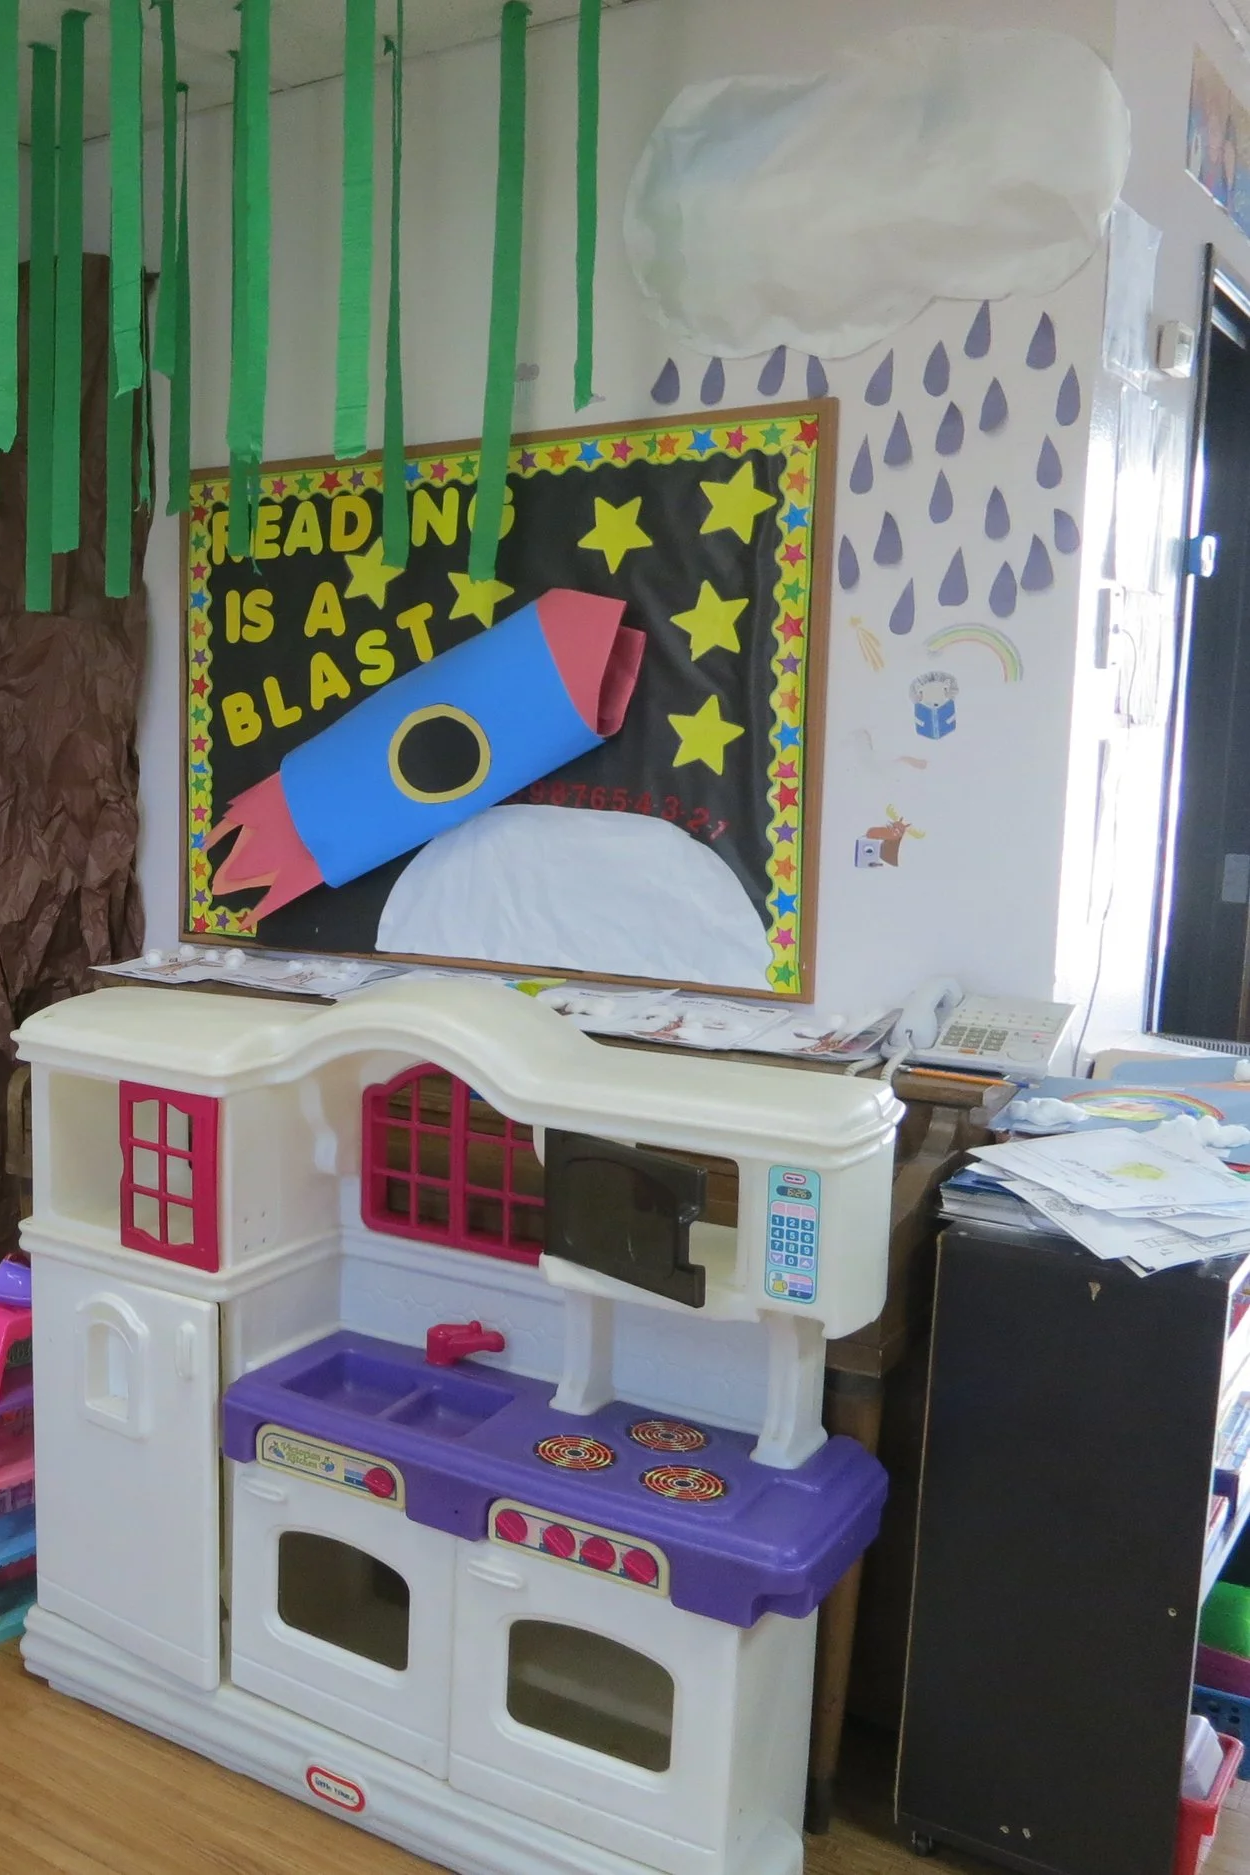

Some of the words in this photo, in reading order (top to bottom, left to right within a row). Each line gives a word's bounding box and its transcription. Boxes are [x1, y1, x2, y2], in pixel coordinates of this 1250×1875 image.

[226, 589, 274, 643] IS
[304, 582, 346, 637] A
[222, 602, 434, 747] BLAST
[789, 1219, 796, 1228] 2
[804, 1221, 811, 1230] 3
[773, 1229, 780, 1237] 4
[789, 1232, 796, 1240] 5
[804, 1233, 811, 1242] 6
[789, 1243, 796, 1252] 8
[804, 1246, 811, 1255] 9
[788, 1255, 795, 1264] 0
